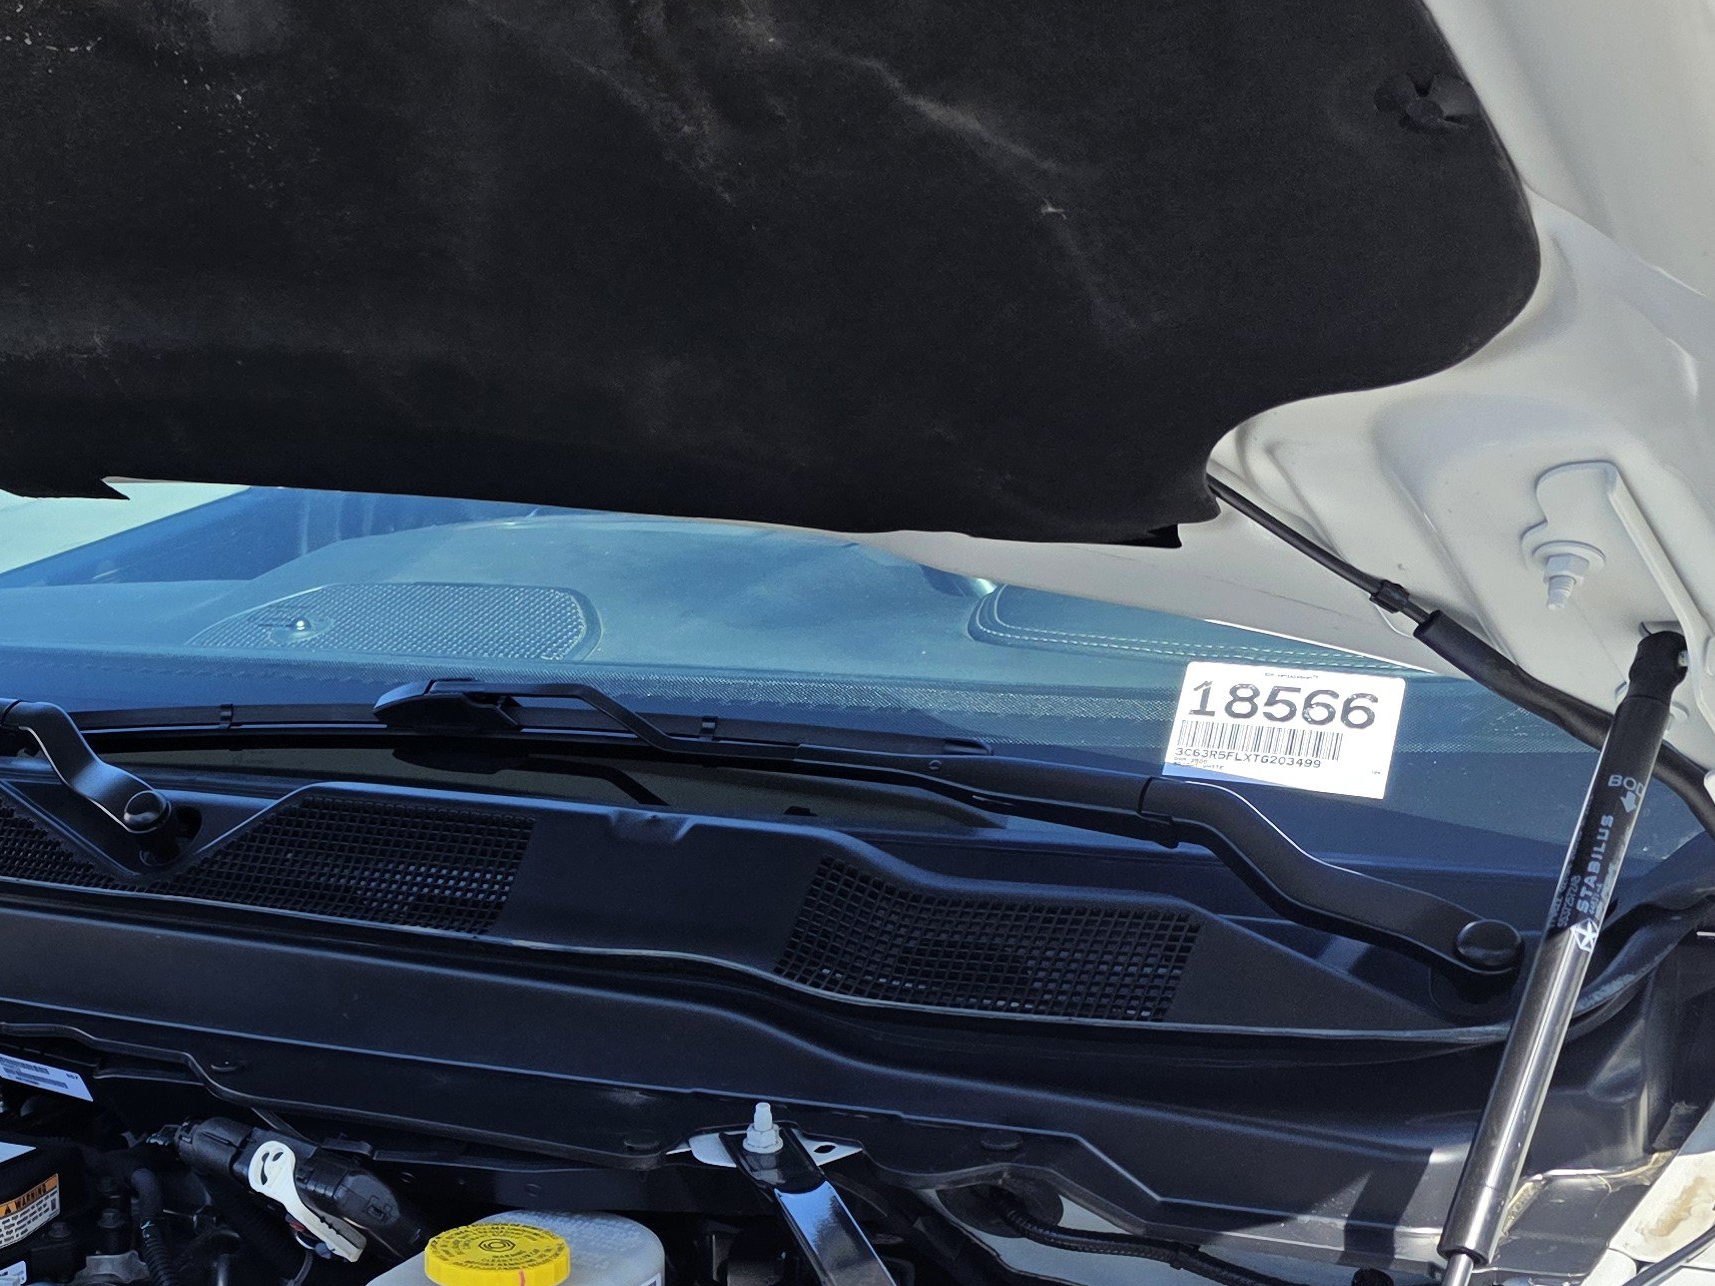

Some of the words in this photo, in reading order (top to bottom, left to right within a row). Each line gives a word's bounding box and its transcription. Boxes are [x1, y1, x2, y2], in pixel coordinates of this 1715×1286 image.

[1188, 680, 1379, 730] 18566
[1174, 747, 1322, 769] 3C63R5FLXTG203499
[1576, 814, 1614, 914] STABILUS
